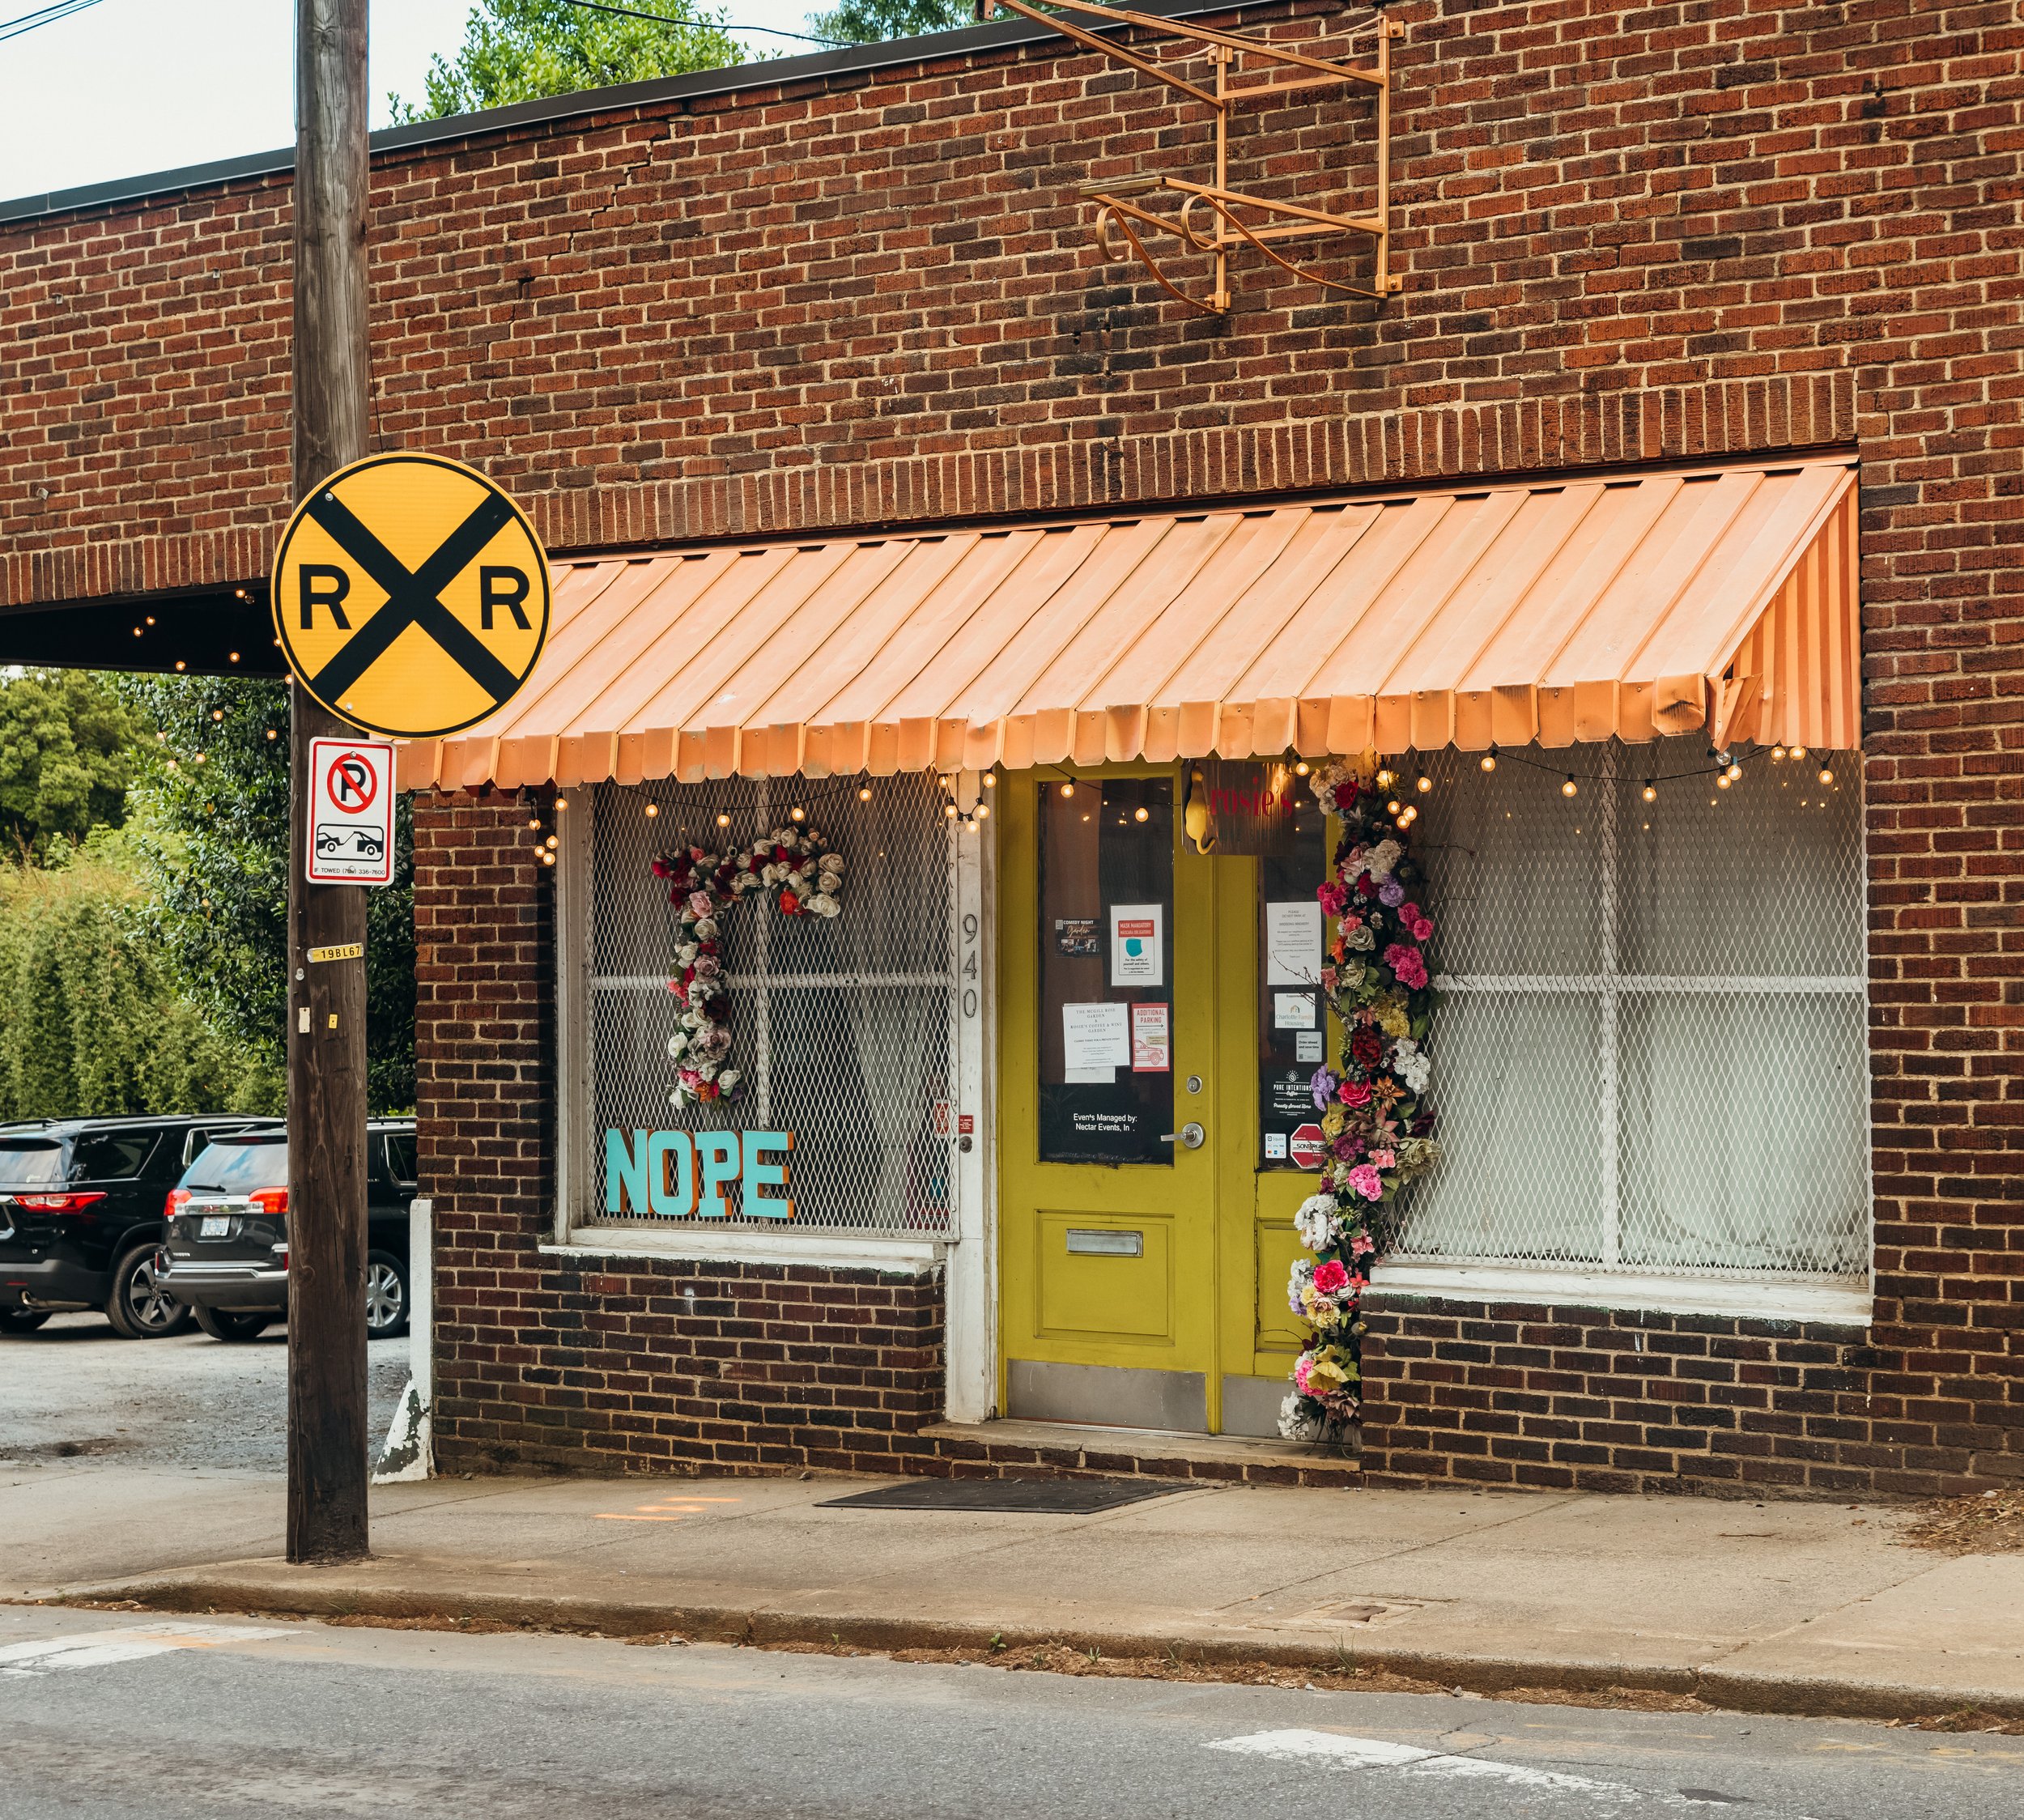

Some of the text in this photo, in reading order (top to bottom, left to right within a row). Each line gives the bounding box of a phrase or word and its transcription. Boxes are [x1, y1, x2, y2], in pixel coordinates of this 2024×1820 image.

[299, 563, 352, 630] R
[479, 565, 533, 630] R
[1210, 776, 1293, 818] rosie's
[321, 946, 360, 959] 19BL67
[962, 913, 978, 1018] 940
[1096, 1113, 1126, 1124] Managed
[1127, 1114, 1137, 1124] by:
[1098, 1123, 1122, 1132] Events,
[606, 1128, 794, 1218] NOPE
